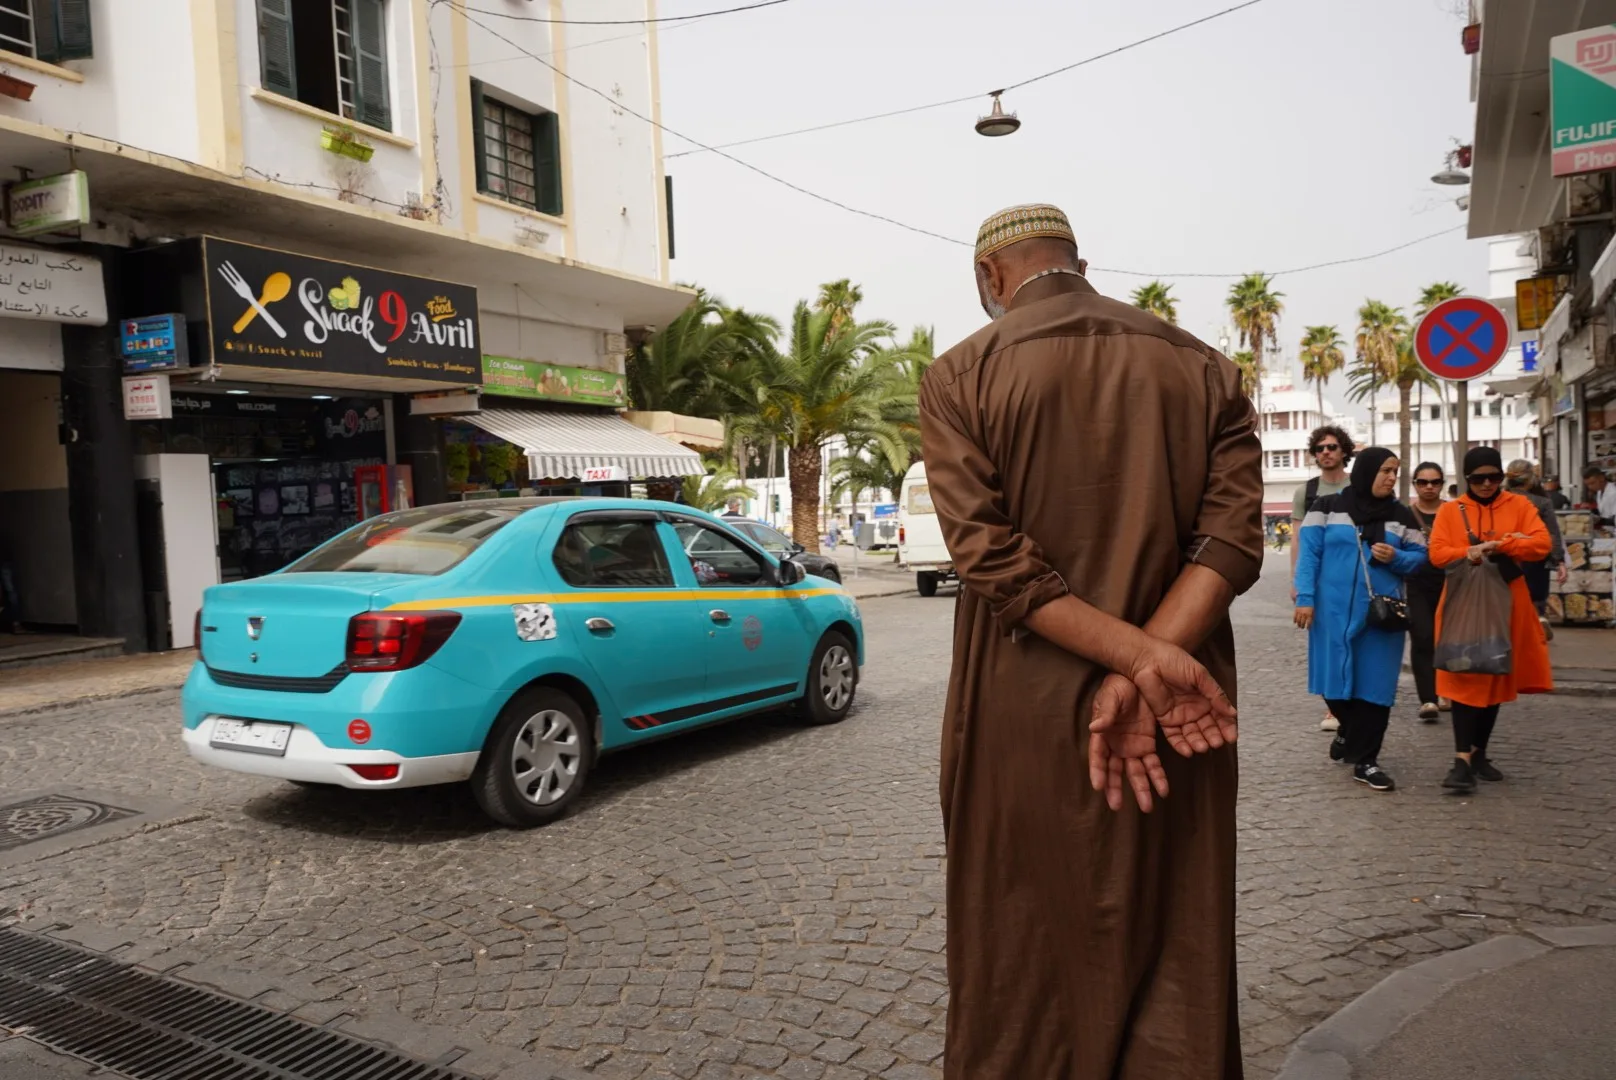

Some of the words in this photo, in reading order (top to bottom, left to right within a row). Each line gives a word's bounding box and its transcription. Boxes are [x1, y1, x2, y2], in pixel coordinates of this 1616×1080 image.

[45, 257, 83, 271] مكتب
[17, 278, 51, 295] التابع
[54, 305, 88, 318] محكمة
[298, 277, 387, 353] Snack
[378, 290, 407, 343] 9
[408, 312, 474, 349] Avril
[237, 402, 277, 412] WELCOME
[586, 468, 612, 480] TAXI
